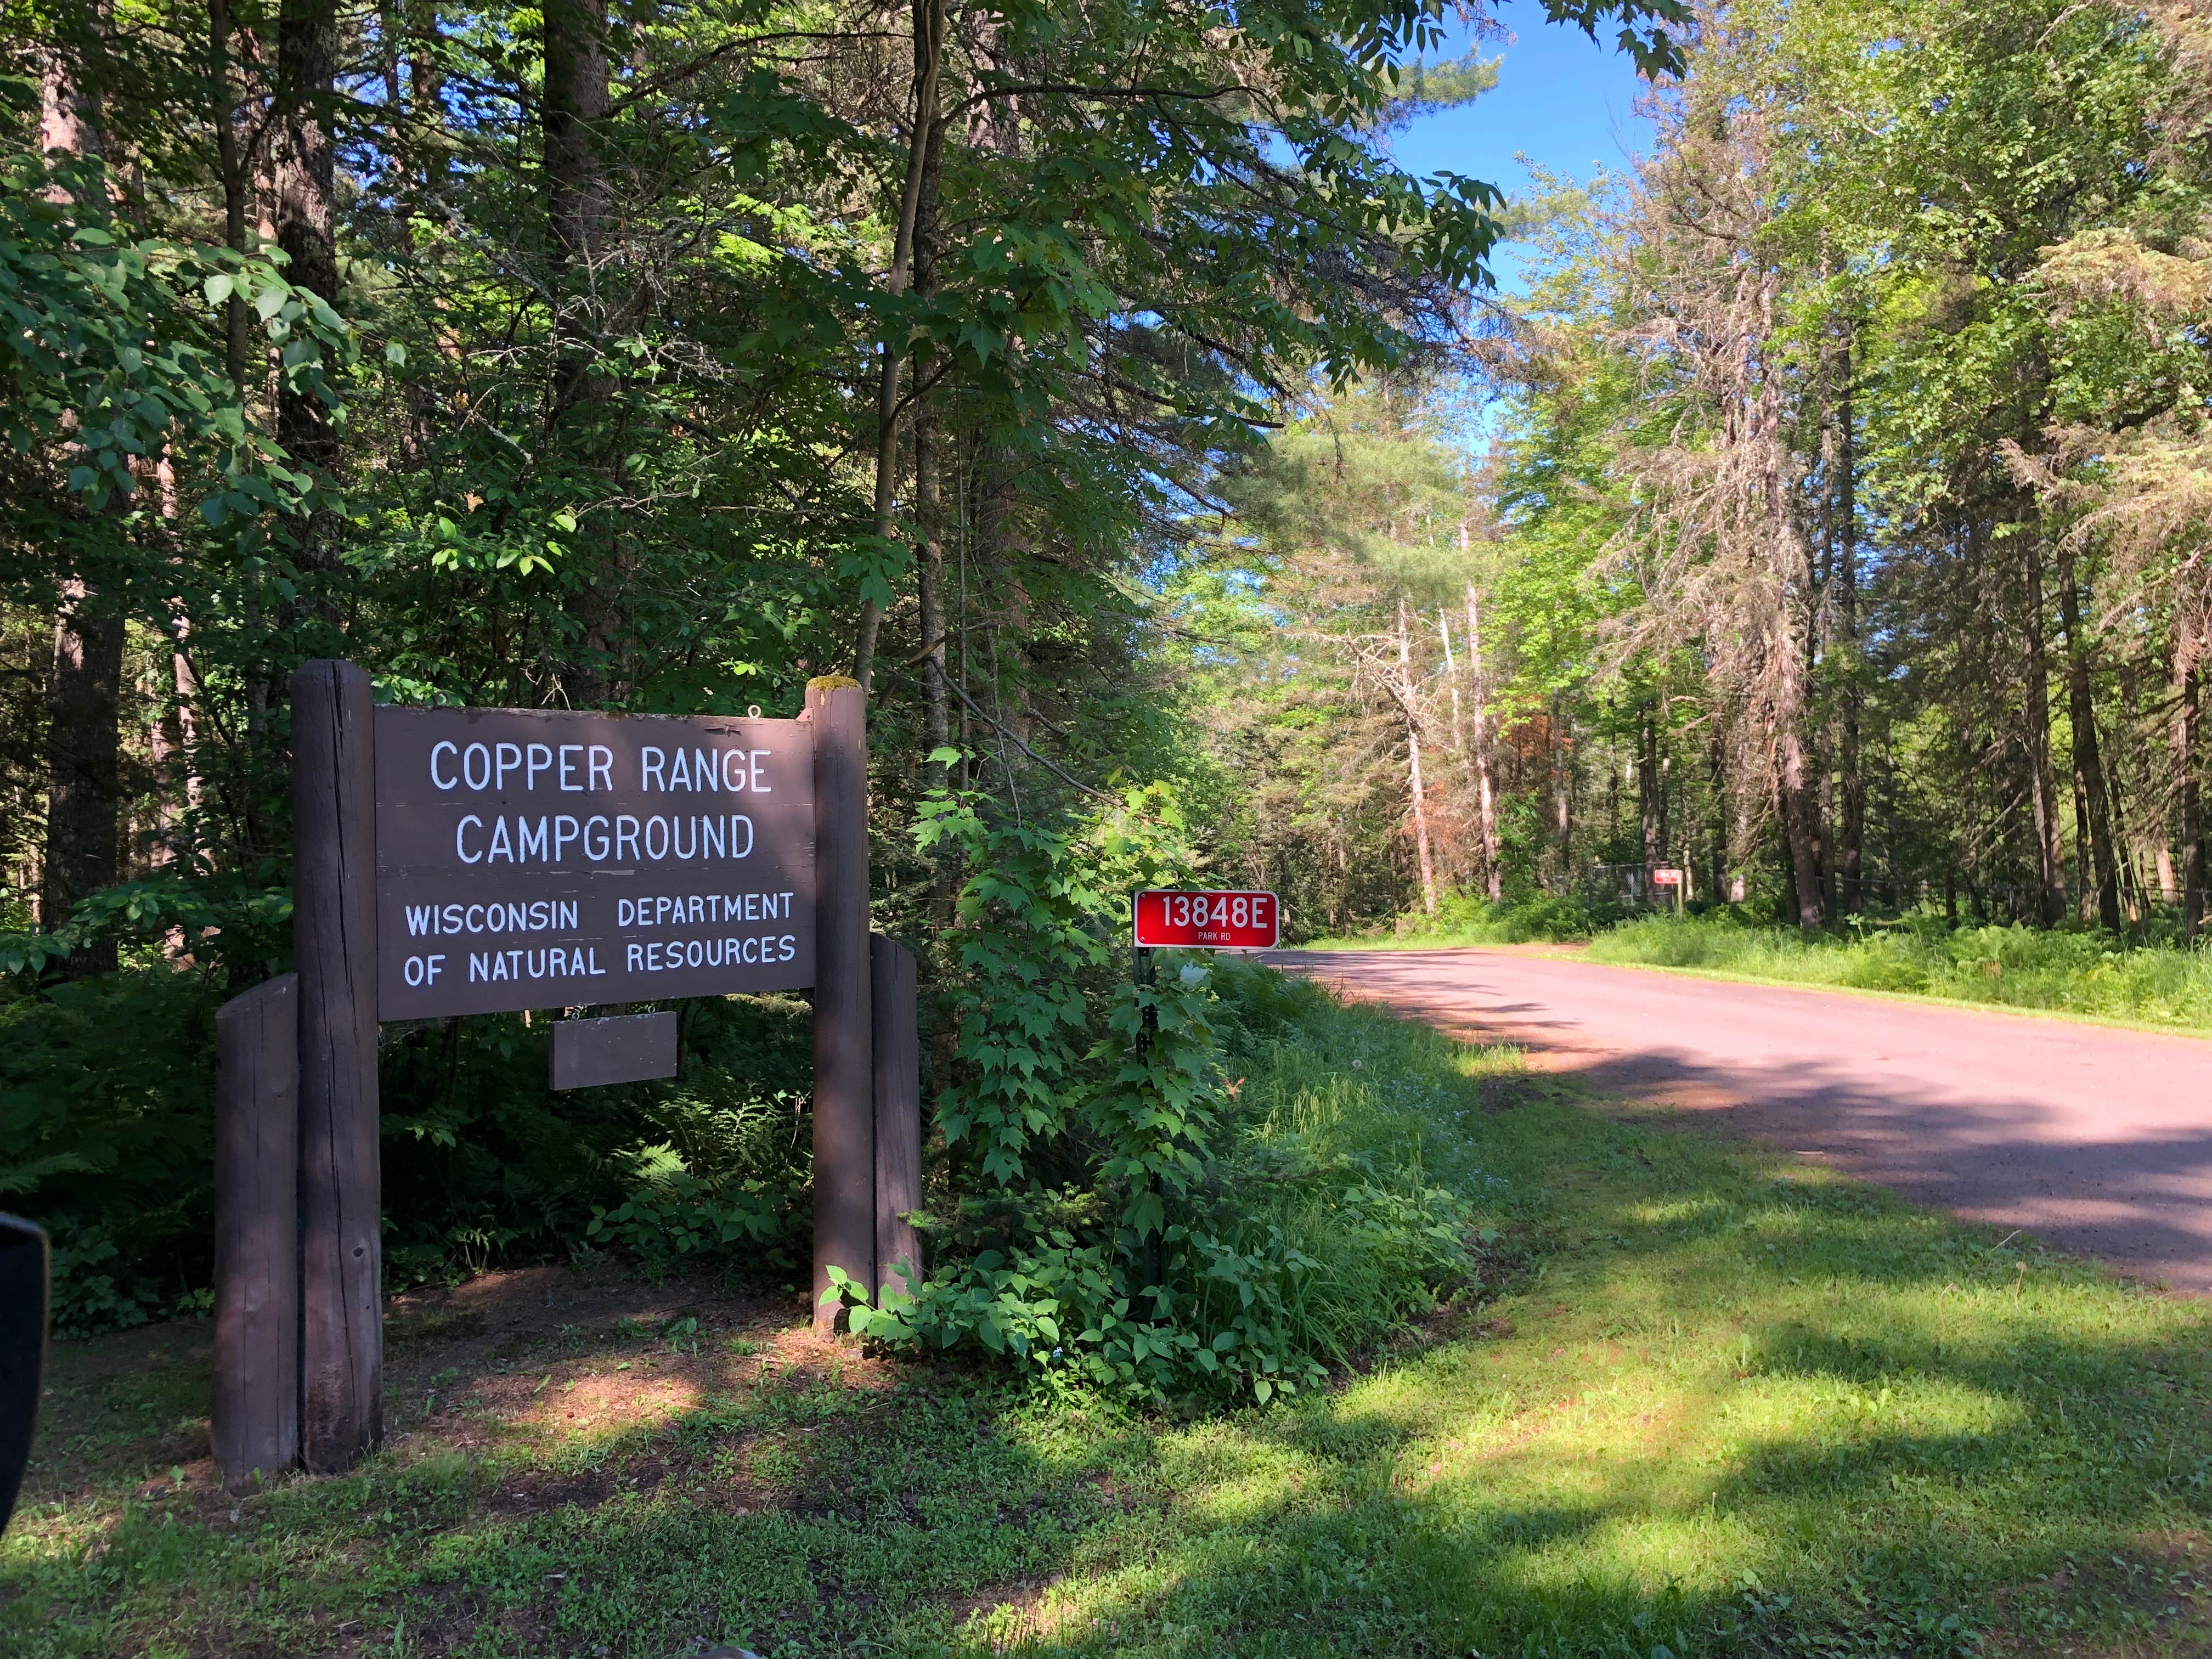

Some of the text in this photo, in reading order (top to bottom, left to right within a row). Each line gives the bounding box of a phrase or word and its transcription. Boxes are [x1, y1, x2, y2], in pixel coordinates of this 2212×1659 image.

[431, 741, 772, 793] COPPER RANGE
[456, 815, 753, 864] CAMPGROUND
[405, 892, 794, 936] WISCONSIN DEPARTMENT
[1163, 896, 1267, 928] 13848E
[1198, 932, 1231, 941] PARK RD
[404, 934, 795, 986] OF NATURAL RESOURCES
